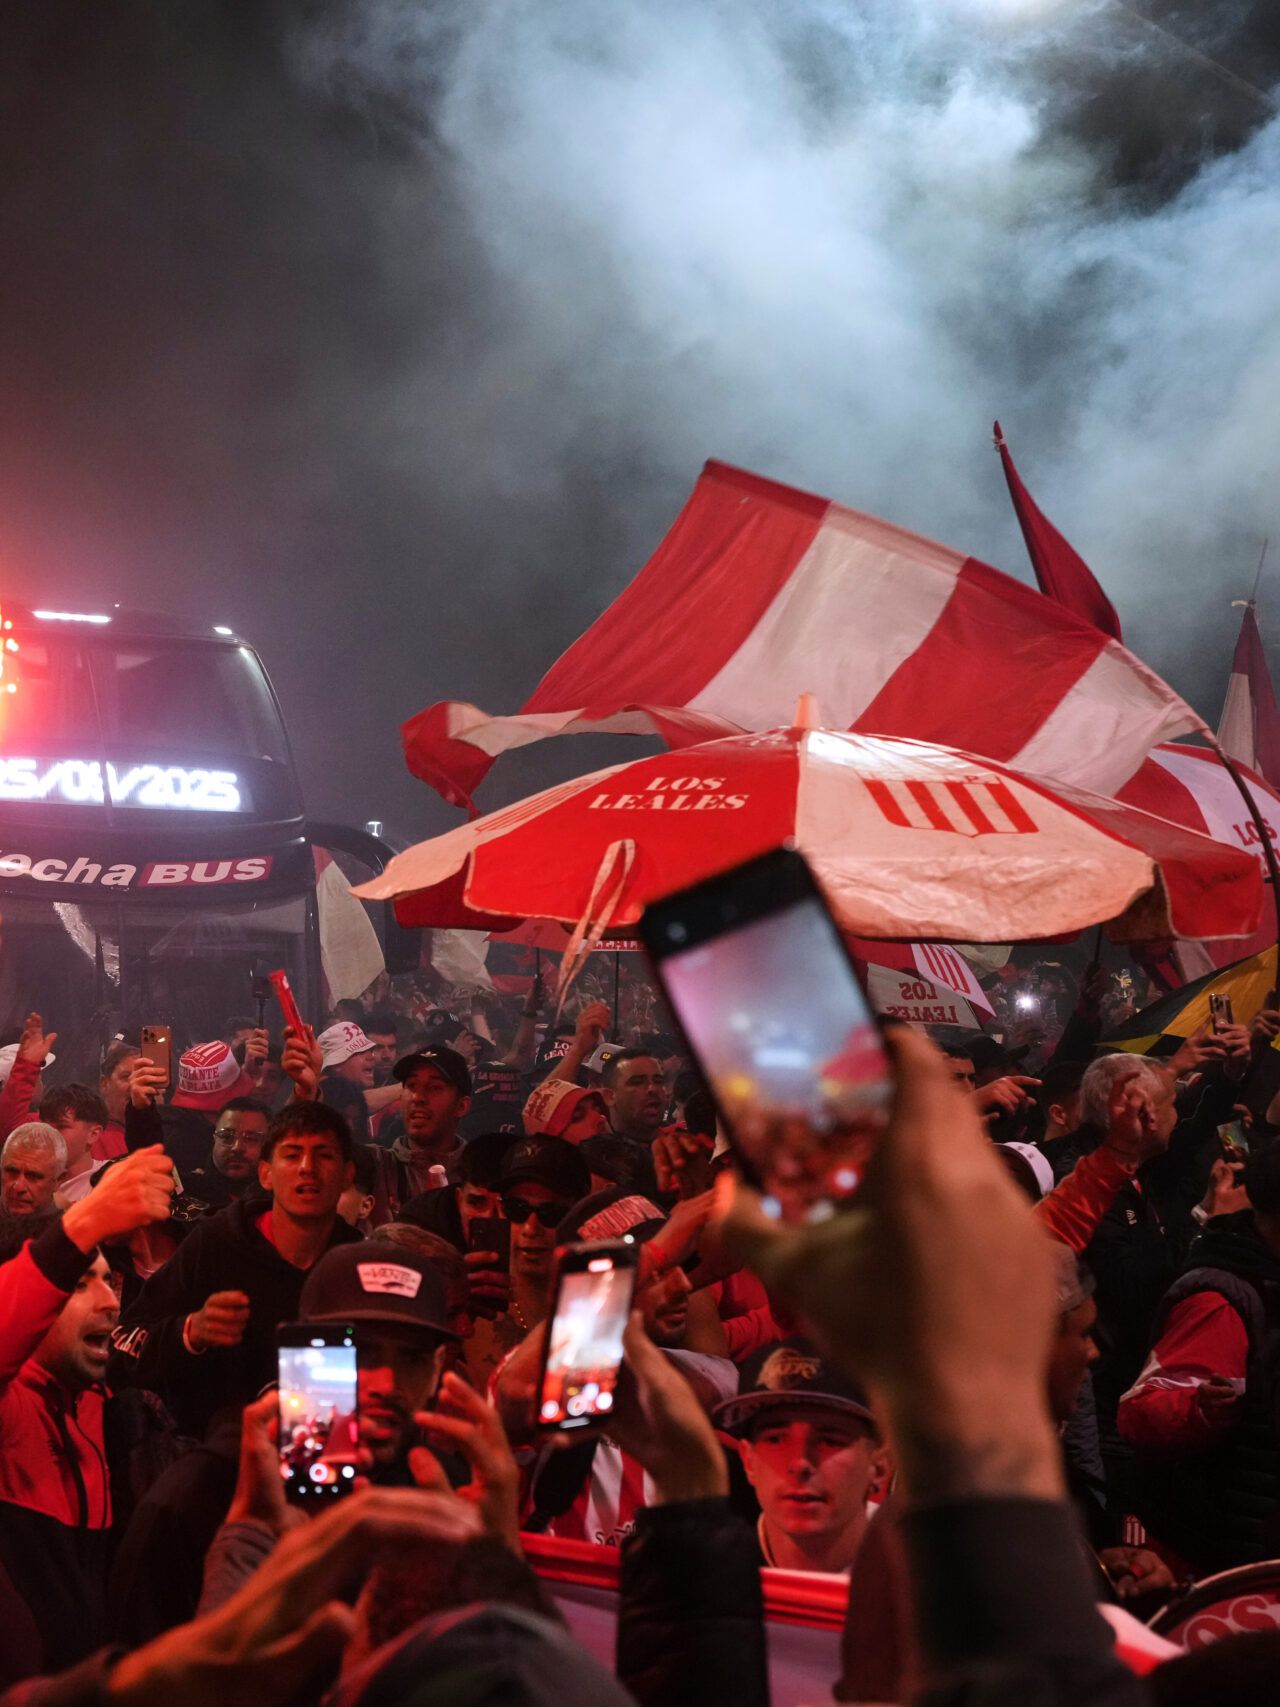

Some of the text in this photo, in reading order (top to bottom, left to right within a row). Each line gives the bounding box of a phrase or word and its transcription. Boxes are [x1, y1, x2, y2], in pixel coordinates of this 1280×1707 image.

[645, 777, 727, 791] LOS
[588, 794, 750, 811] LEALES
[343, 1025, 363, 1042] 32
[554, 1041, 572, 1049] LO
